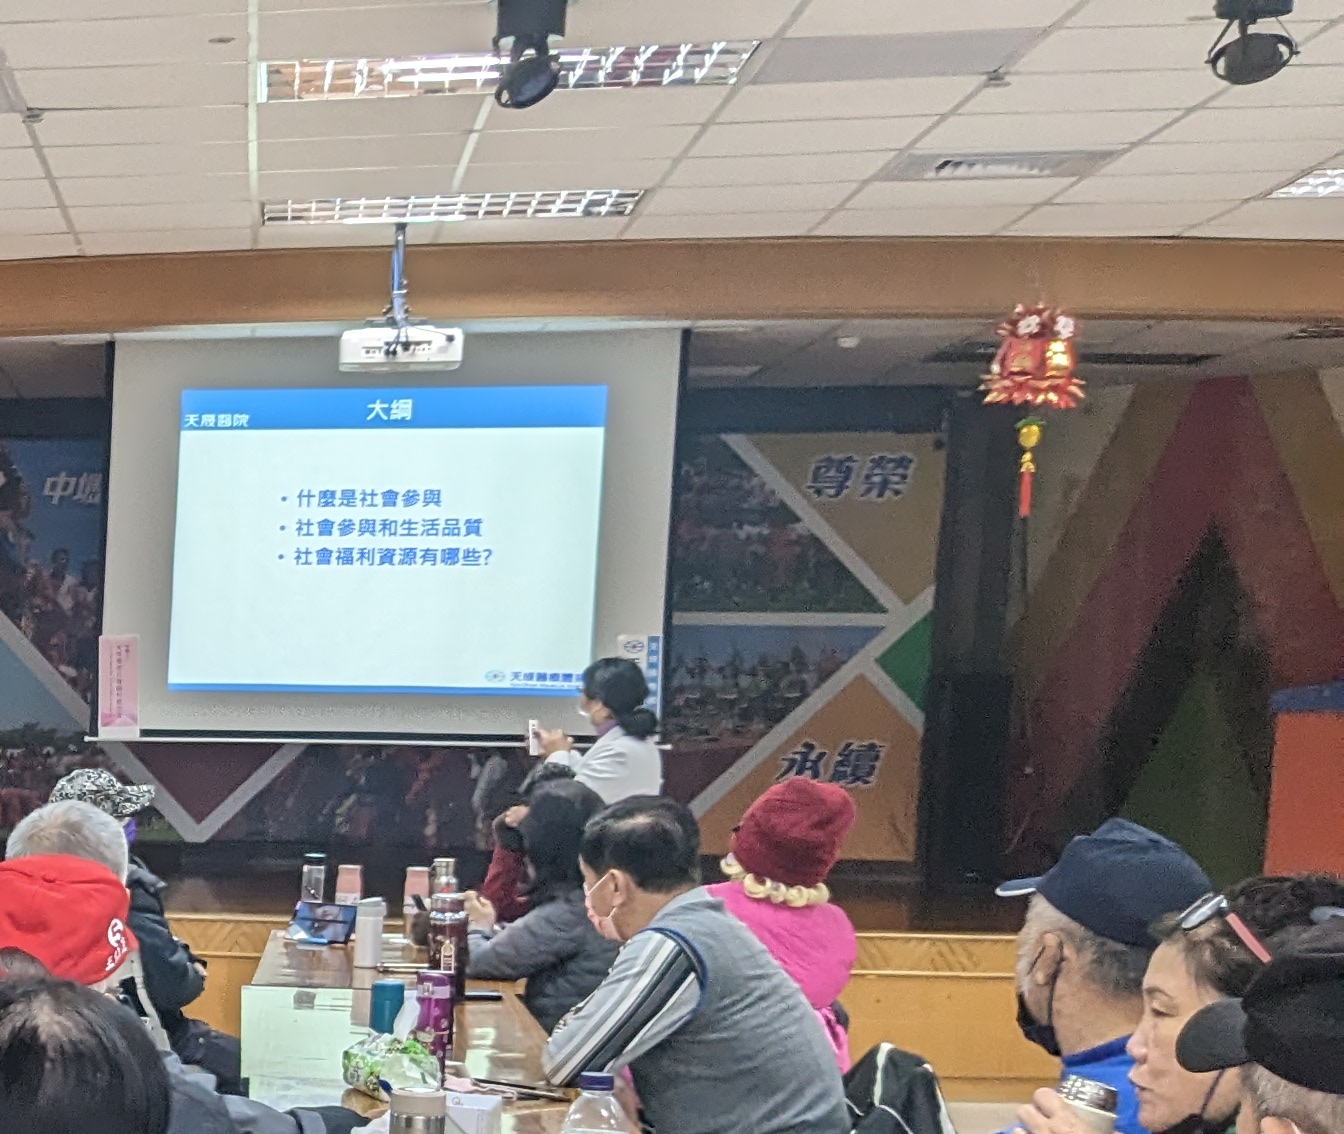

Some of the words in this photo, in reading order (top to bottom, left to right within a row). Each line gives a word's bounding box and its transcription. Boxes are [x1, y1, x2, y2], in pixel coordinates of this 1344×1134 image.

[366, 398, 413, 421] 大綱
[806, 454, 915, 499] 尊榮
[296, 488, 443, 508] 什麼是社會參與
[295, 518, 483, 538] 社會參與和生活品質
[293, 547, 493, 567] 社會福利資源有哪些?
[774, 741, 887, 785] 永續
